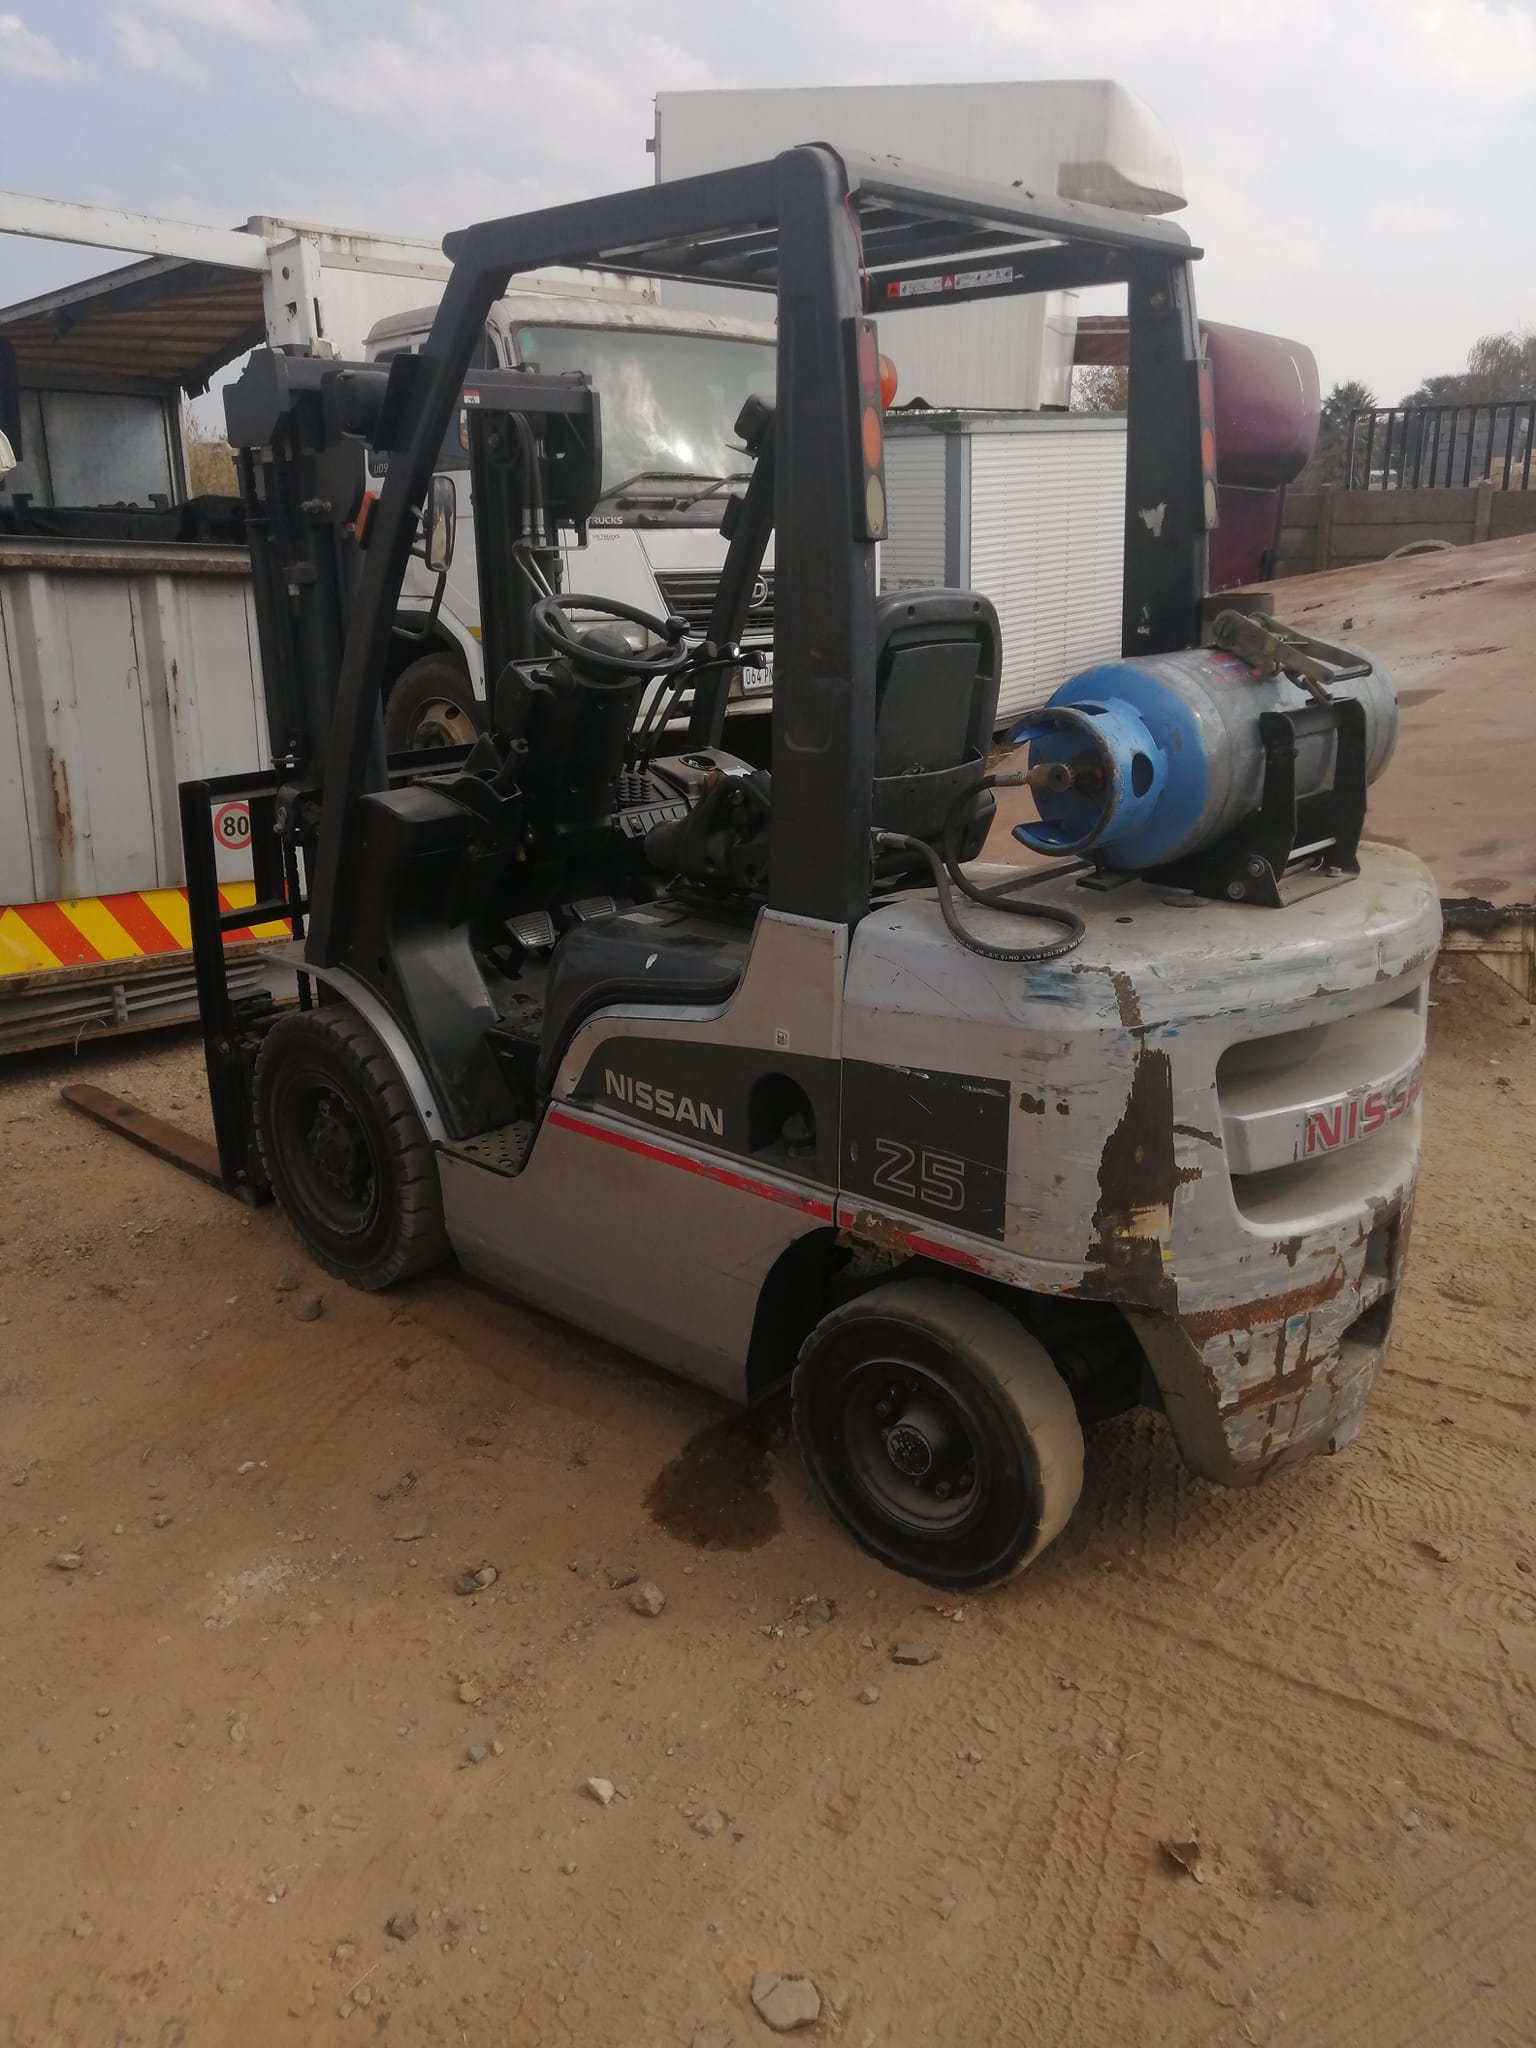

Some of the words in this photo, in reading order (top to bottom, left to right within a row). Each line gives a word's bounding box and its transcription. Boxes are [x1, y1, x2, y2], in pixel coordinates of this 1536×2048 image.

[373, 463, 388, 473] UD9
[223, 816, 249, 837] 80
[605, 1068, 723, 1136] NISSAN
[1305, 1060, 1422, 1154] NISS
[873, 1137, 965, 1211] 25
